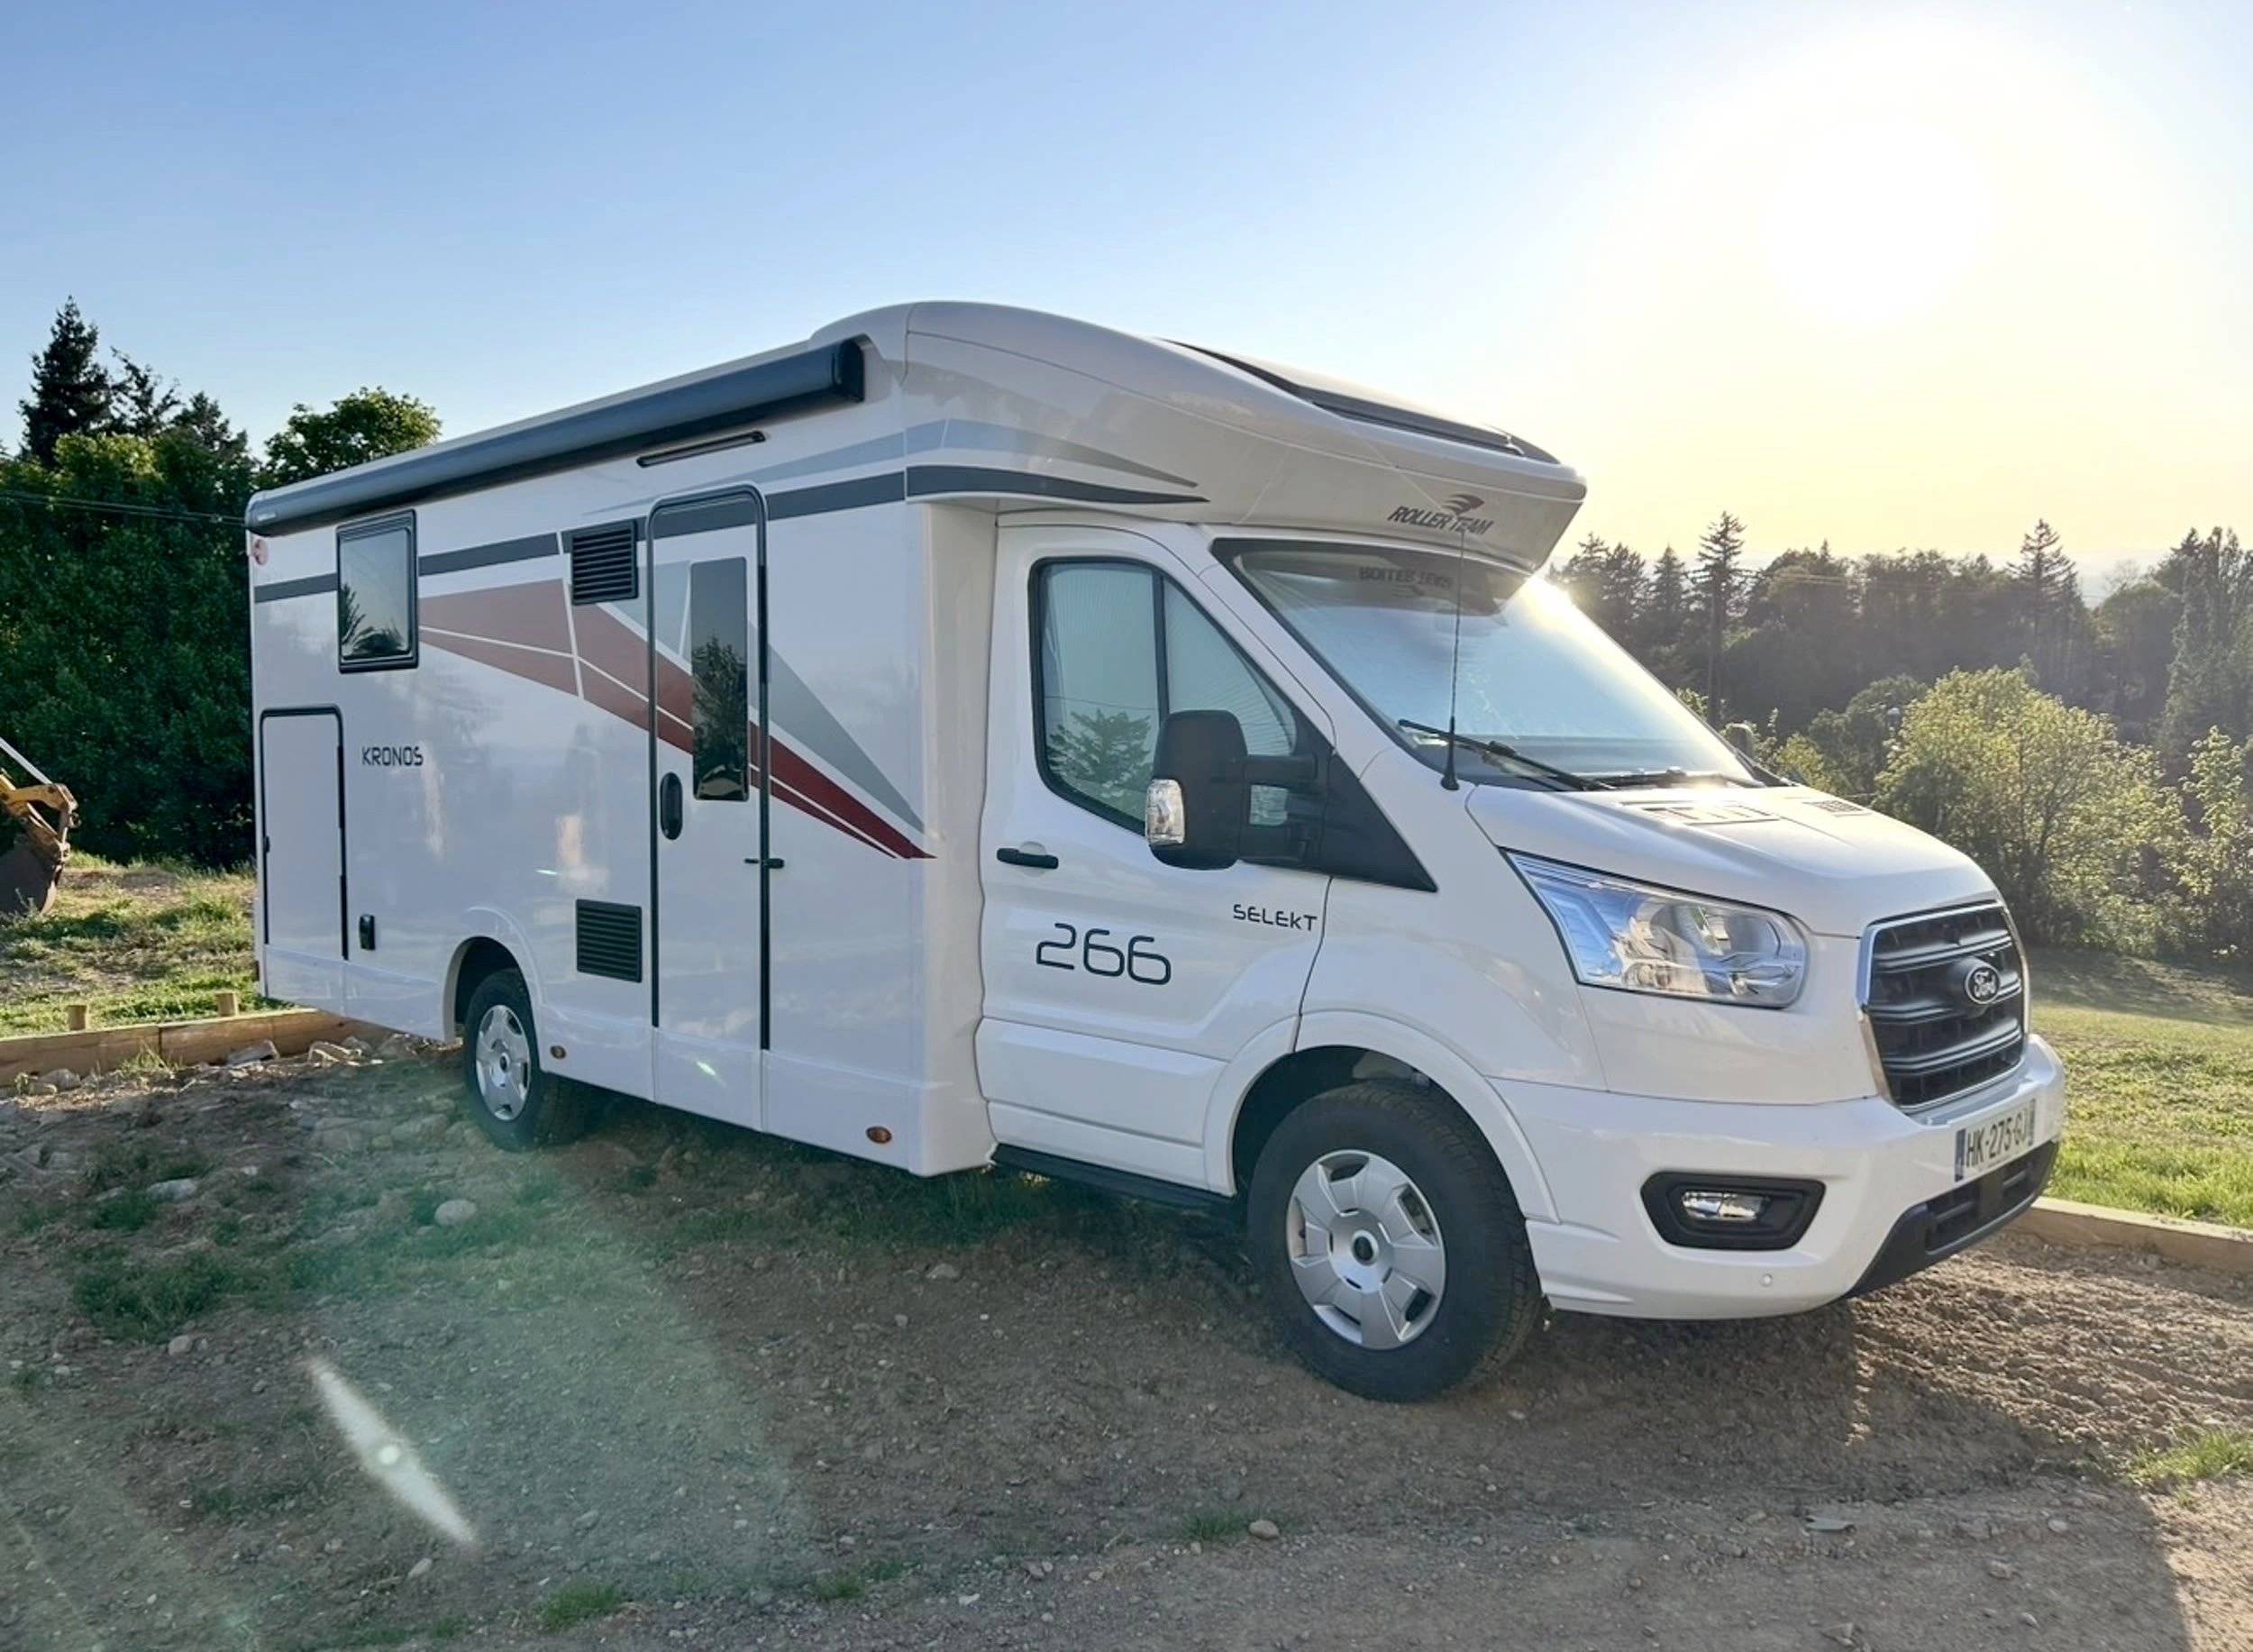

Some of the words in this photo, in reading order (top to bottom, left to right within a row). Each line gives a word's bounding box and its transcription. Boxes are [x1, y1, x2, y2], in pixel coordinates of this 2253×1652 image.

[1387, 506, 1452, 530] ROLLER
[1449, 516, 1495, 535] TEAM
[361, 745, 424, 767] KRONOS
[1233, 903, 1318, 932] SELEKT
[1035, 922, 1172, 986] 266
